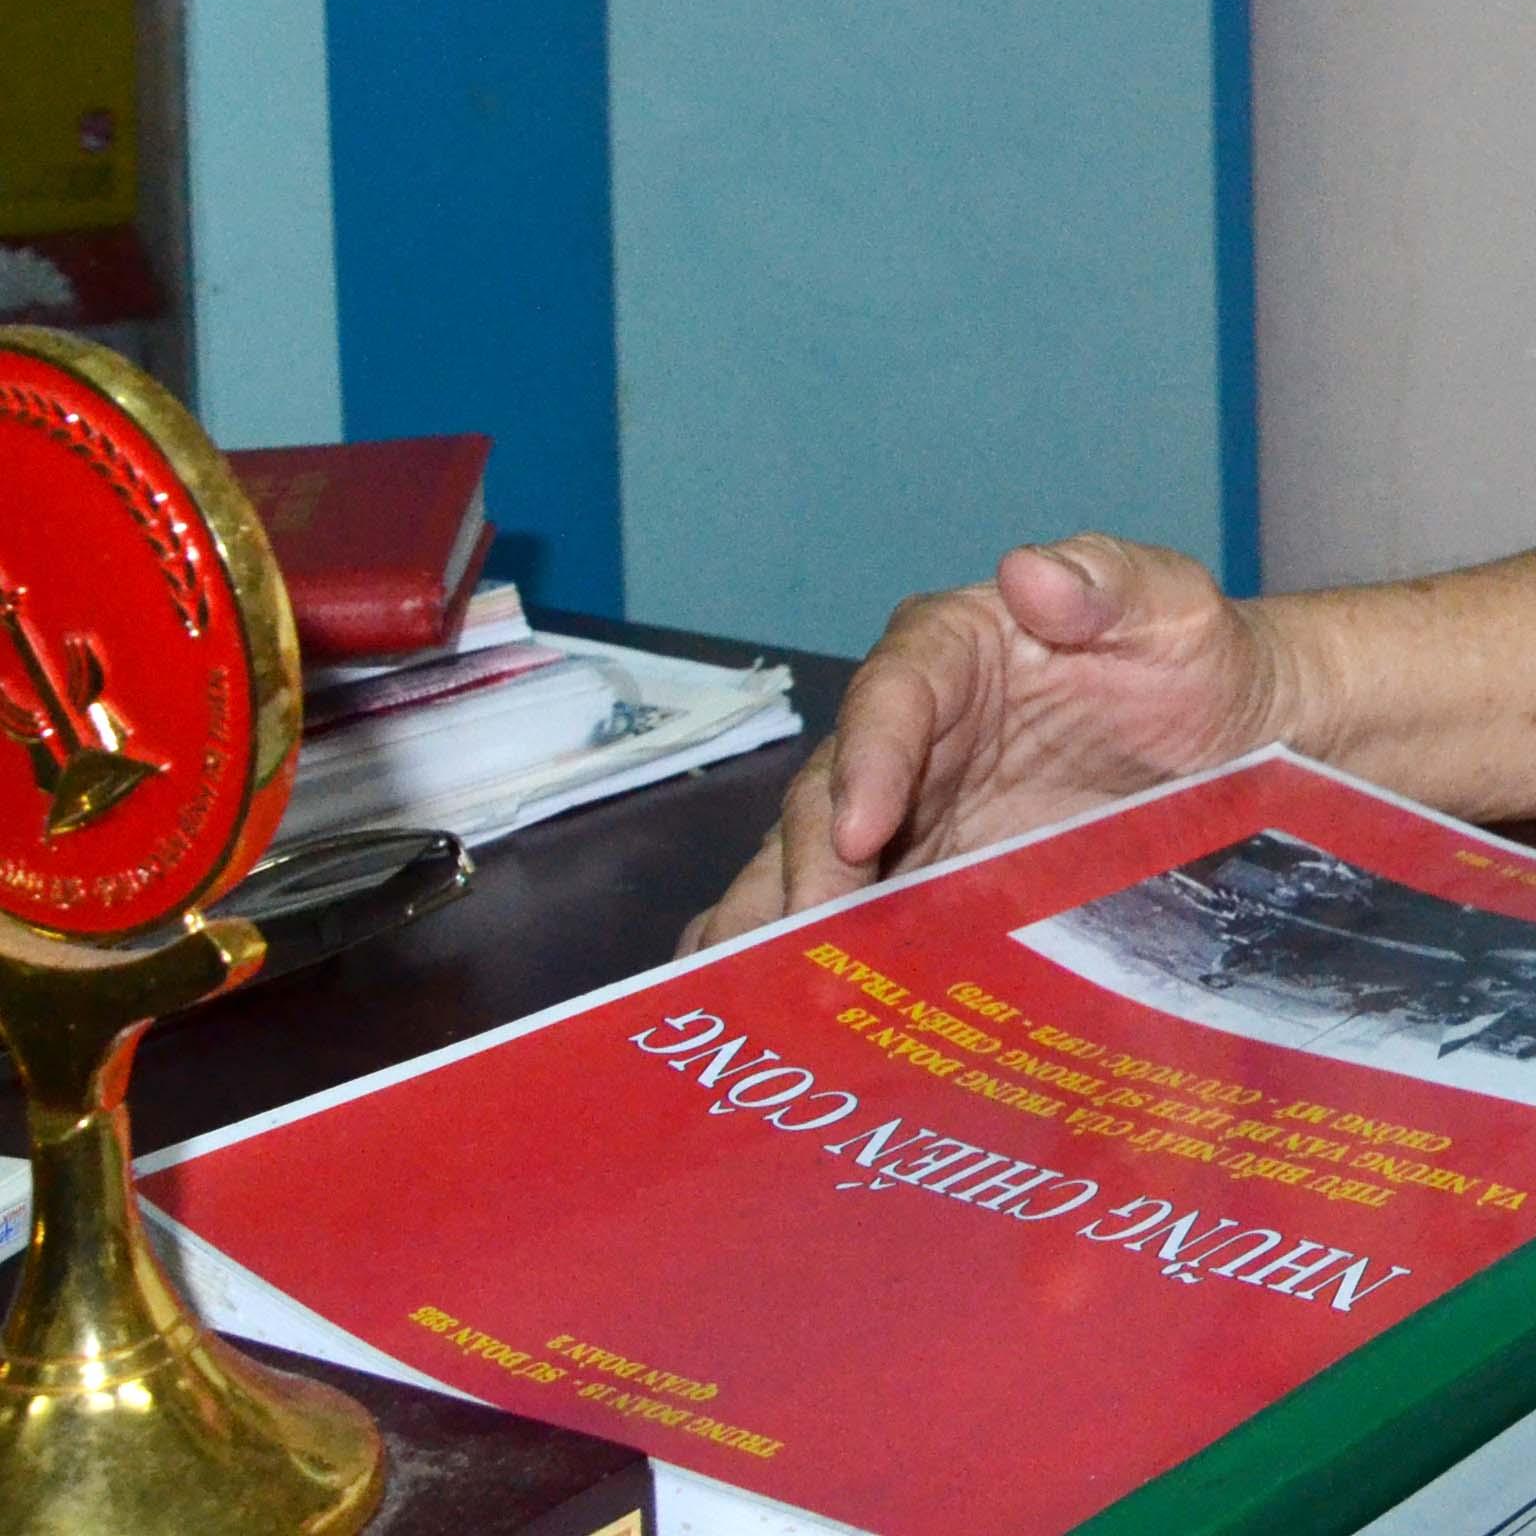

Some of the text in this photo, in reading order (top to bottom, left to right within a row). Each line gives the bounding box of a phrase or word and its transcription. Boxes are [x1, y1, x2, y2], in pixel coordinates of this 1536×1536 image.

[804, 943, 909, 1006] TRANH
[946, 982, 1021, 1023] 1975)
[899, 1001, 1002, 1054] CHIẾN
[994, 1049, 1105, 1096] TRONG
[836, 1007, 1397, 1209] TIÊU BIỂU NHẤT CỦA TRUNG ĐOÀN 18
[1147, 1098, 1236, 1131] LỊCH
[1274, 1131, 1351, 1164] VẤN
[1328, 1112, 1453, 1154] CHỐNG
[628, 1007, 1413, 1314] NHỮNG CHIẾN CÔNG
[1348, 1150, 1482, 1195] NHỮNG
[1476, 1183, 1528, 1211] VÀ
[544, 1333, 576, 1350] 2
[634, 1369, 720, 1403] QUÂN
[681, 1415, 785, 1459] TRUNG
